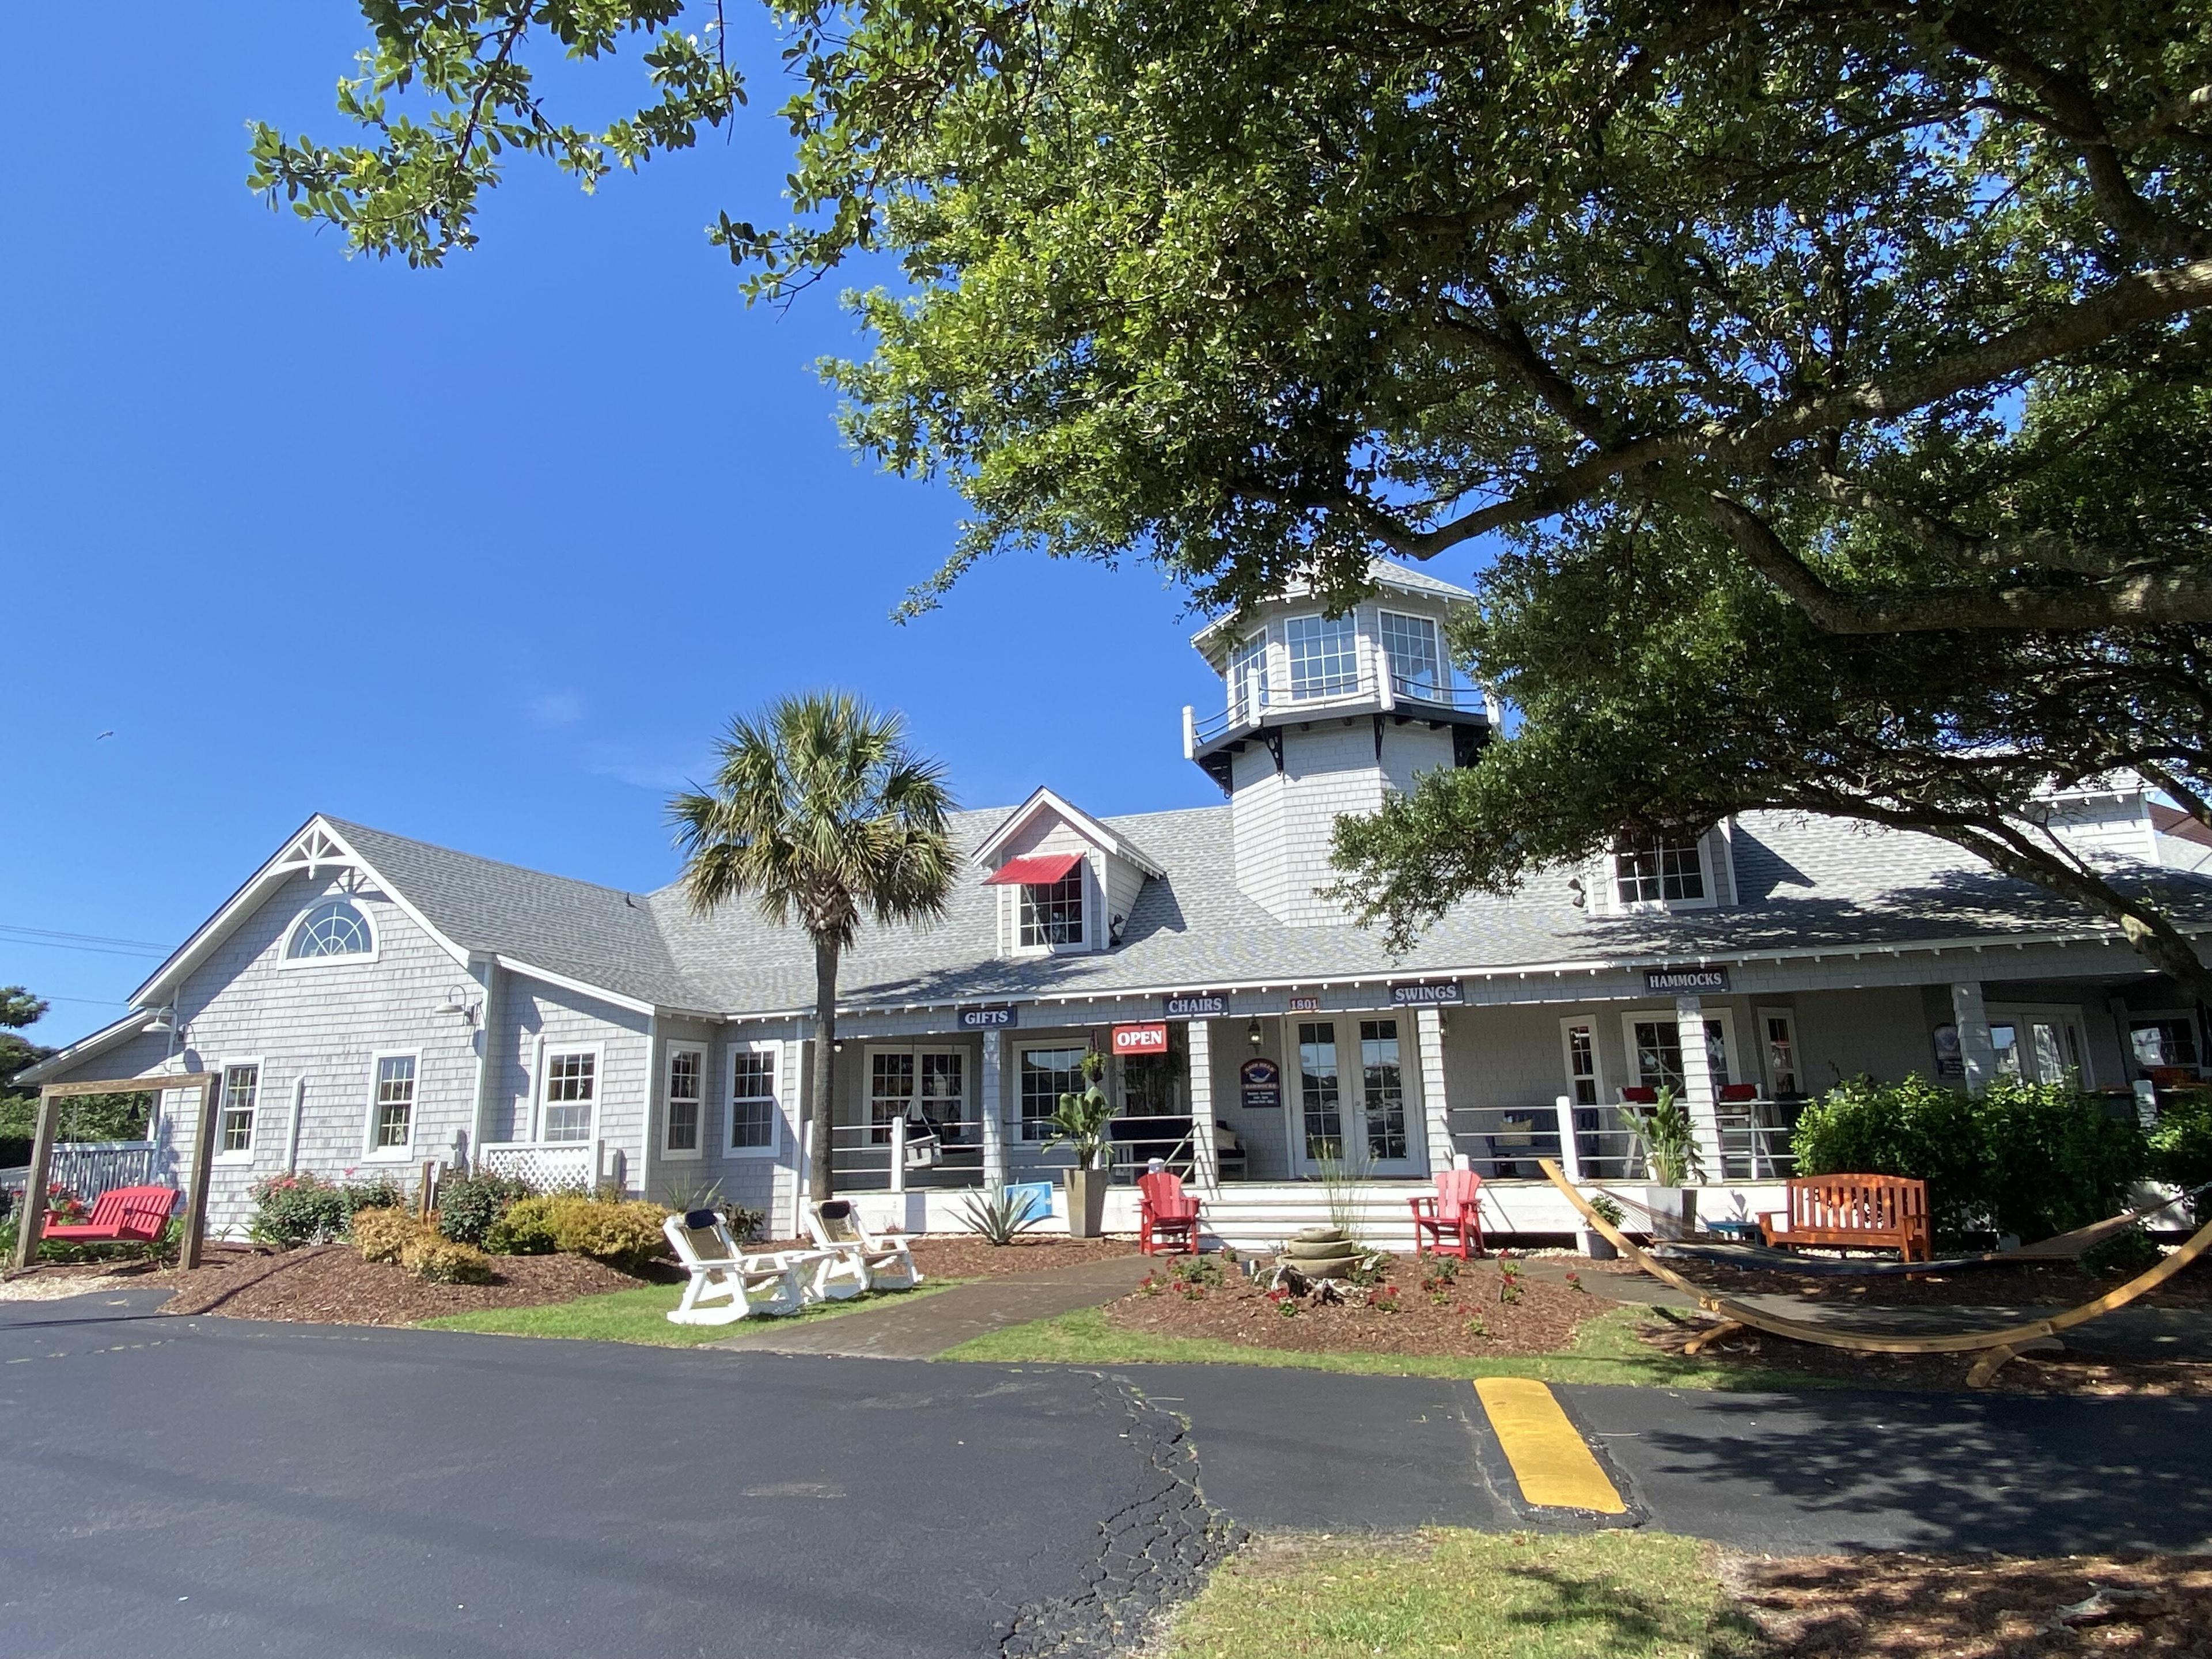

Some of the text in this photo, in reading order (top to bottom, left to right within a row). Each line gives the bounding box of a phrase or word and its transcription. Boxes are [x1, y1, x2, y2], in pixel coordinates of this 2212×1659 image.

[1649, 973, 1722, 988] HAMMOCKS
[1395, 985, 1457, 1001] SWINGS
[1169, 998, 1222, 1013] CHAIRS
[1291, 999, 1317, 1010] 1801
[964, 1010, 1008, 1024] GIFTS
[1117, 1030, 1162, 1046] OPEN
